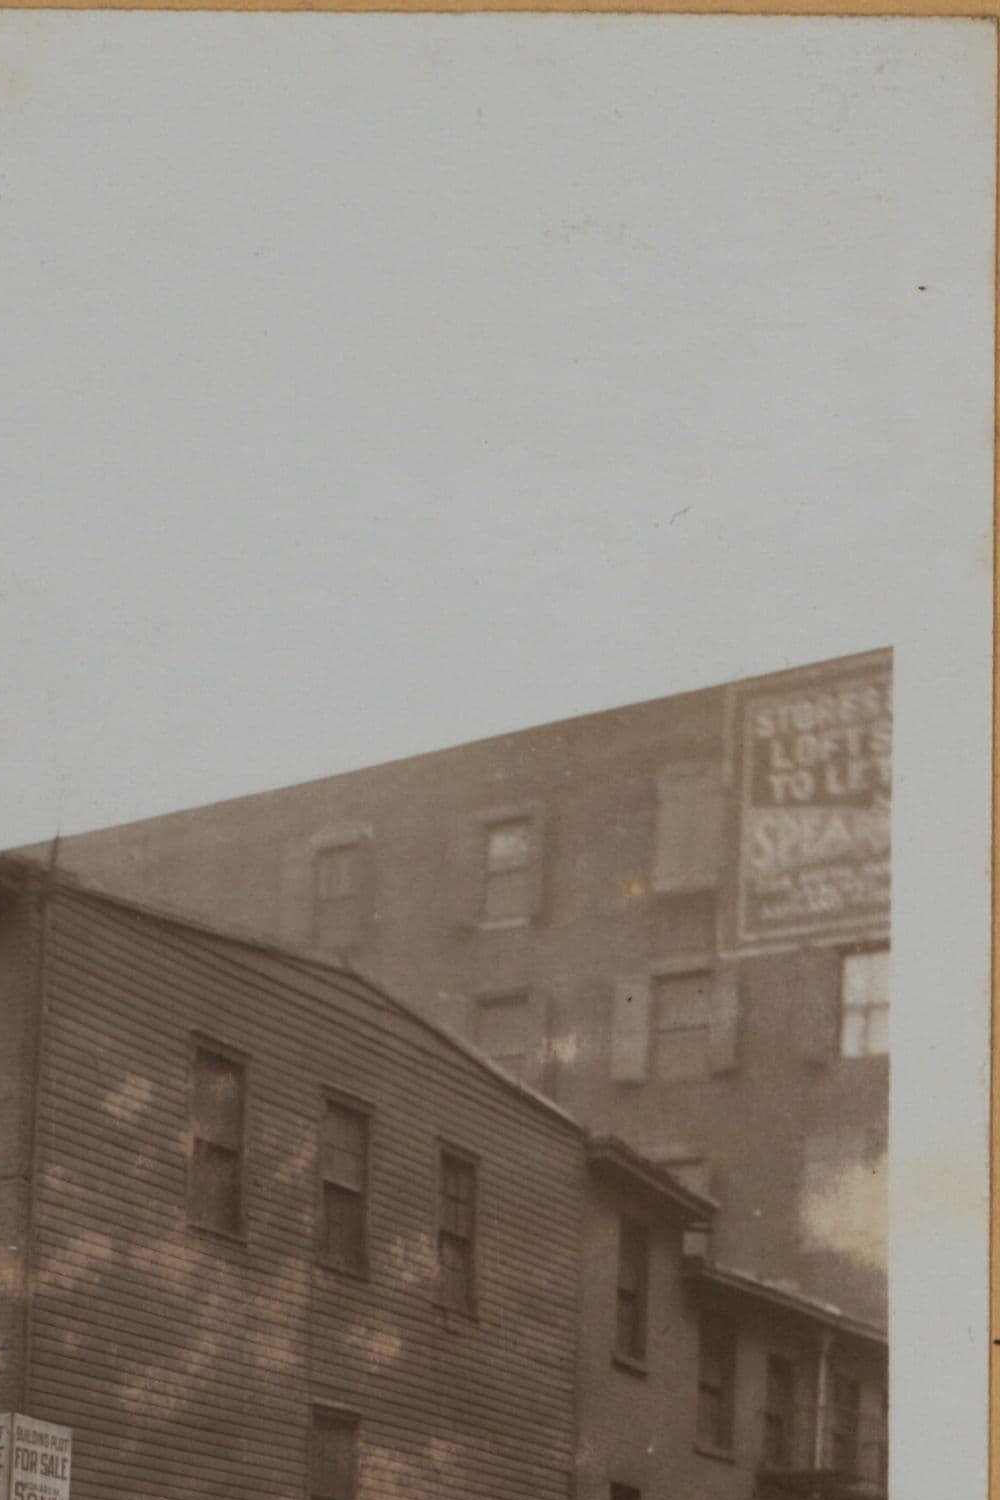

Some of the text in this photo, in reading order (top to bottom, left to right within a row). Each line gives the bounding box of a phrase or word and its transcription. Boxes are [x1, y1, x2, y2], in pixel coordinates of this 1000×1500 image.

[768, 770, 816, 802] TO
[15, 1447, 68, 1480] FOR SALE
